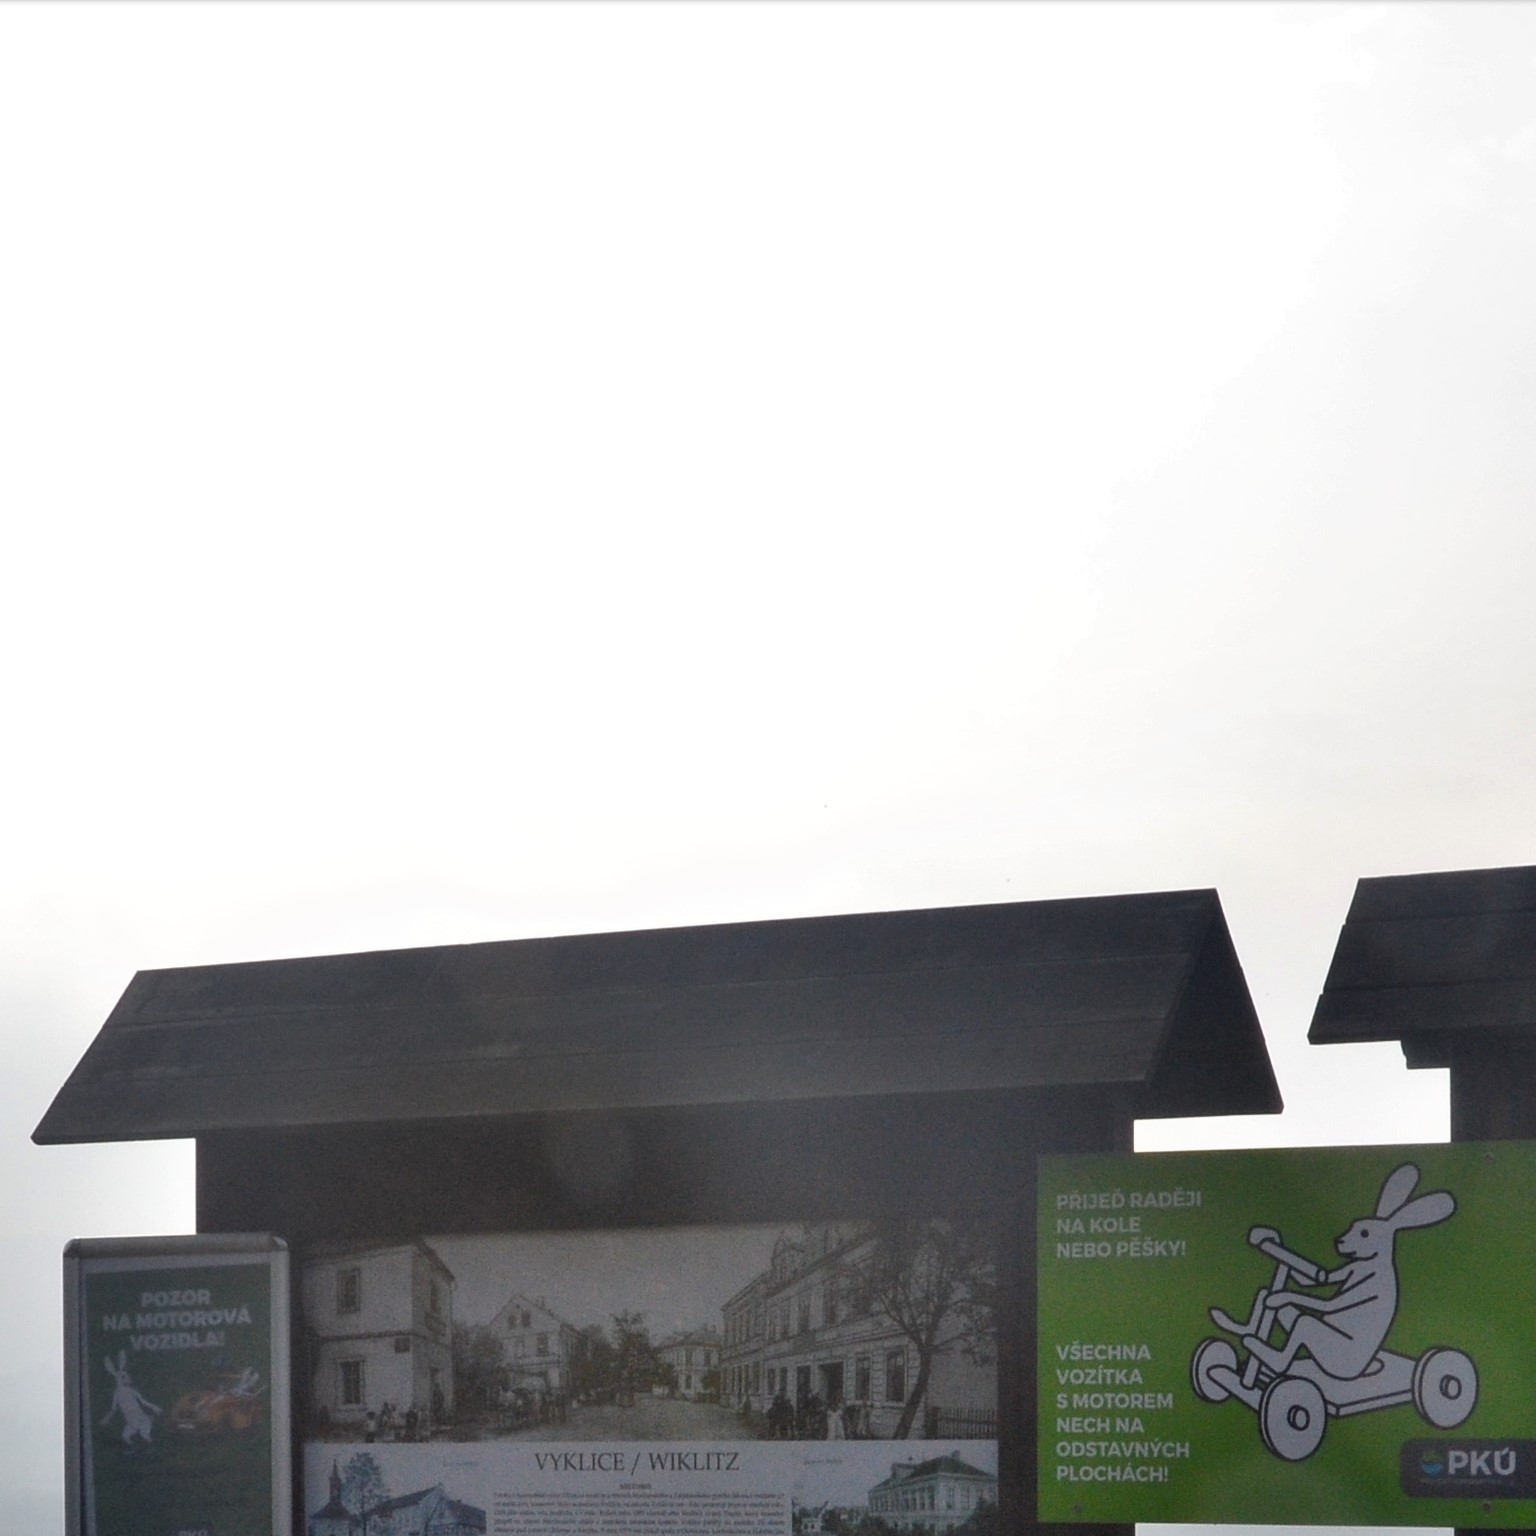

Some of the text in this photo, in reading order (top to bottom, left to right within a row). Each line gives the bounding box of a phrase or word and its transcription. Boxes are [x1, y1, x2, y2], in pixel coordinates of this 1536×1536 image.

[1056, 1186, 1202, 1210] PŘIJEĎ RADĚJI
[1056, 1216, 1142, 1234] NA KOLE
[1056, 1236, 1186, 1259] NEBO PĚŠKY!
[141, 1288, 211, 1307] POZOR
[103, 1303, 252, 1331] NA MOTOROVÁ
[129, 1331, 225, 1350] VOZIDLA!
[1056, 1340, 1152, 1361] VŠECHNA
[1056, 1364, 1144, 1385] VOZÍTKA
[1056, 1393, 1173, 1409] S MOTOREM
[1056, 1417, 1144, 1434] NECH NA
[1055, 1438, 1190, 1458] ODSTAVNÝCH
[534, 1451, 741, 1476] VYKLICE / WIKLITZ
[1448, 1447, 1517, 1476] PKÚ
[1056, 1462, 1169, 1482] PLOCHÁCH!
